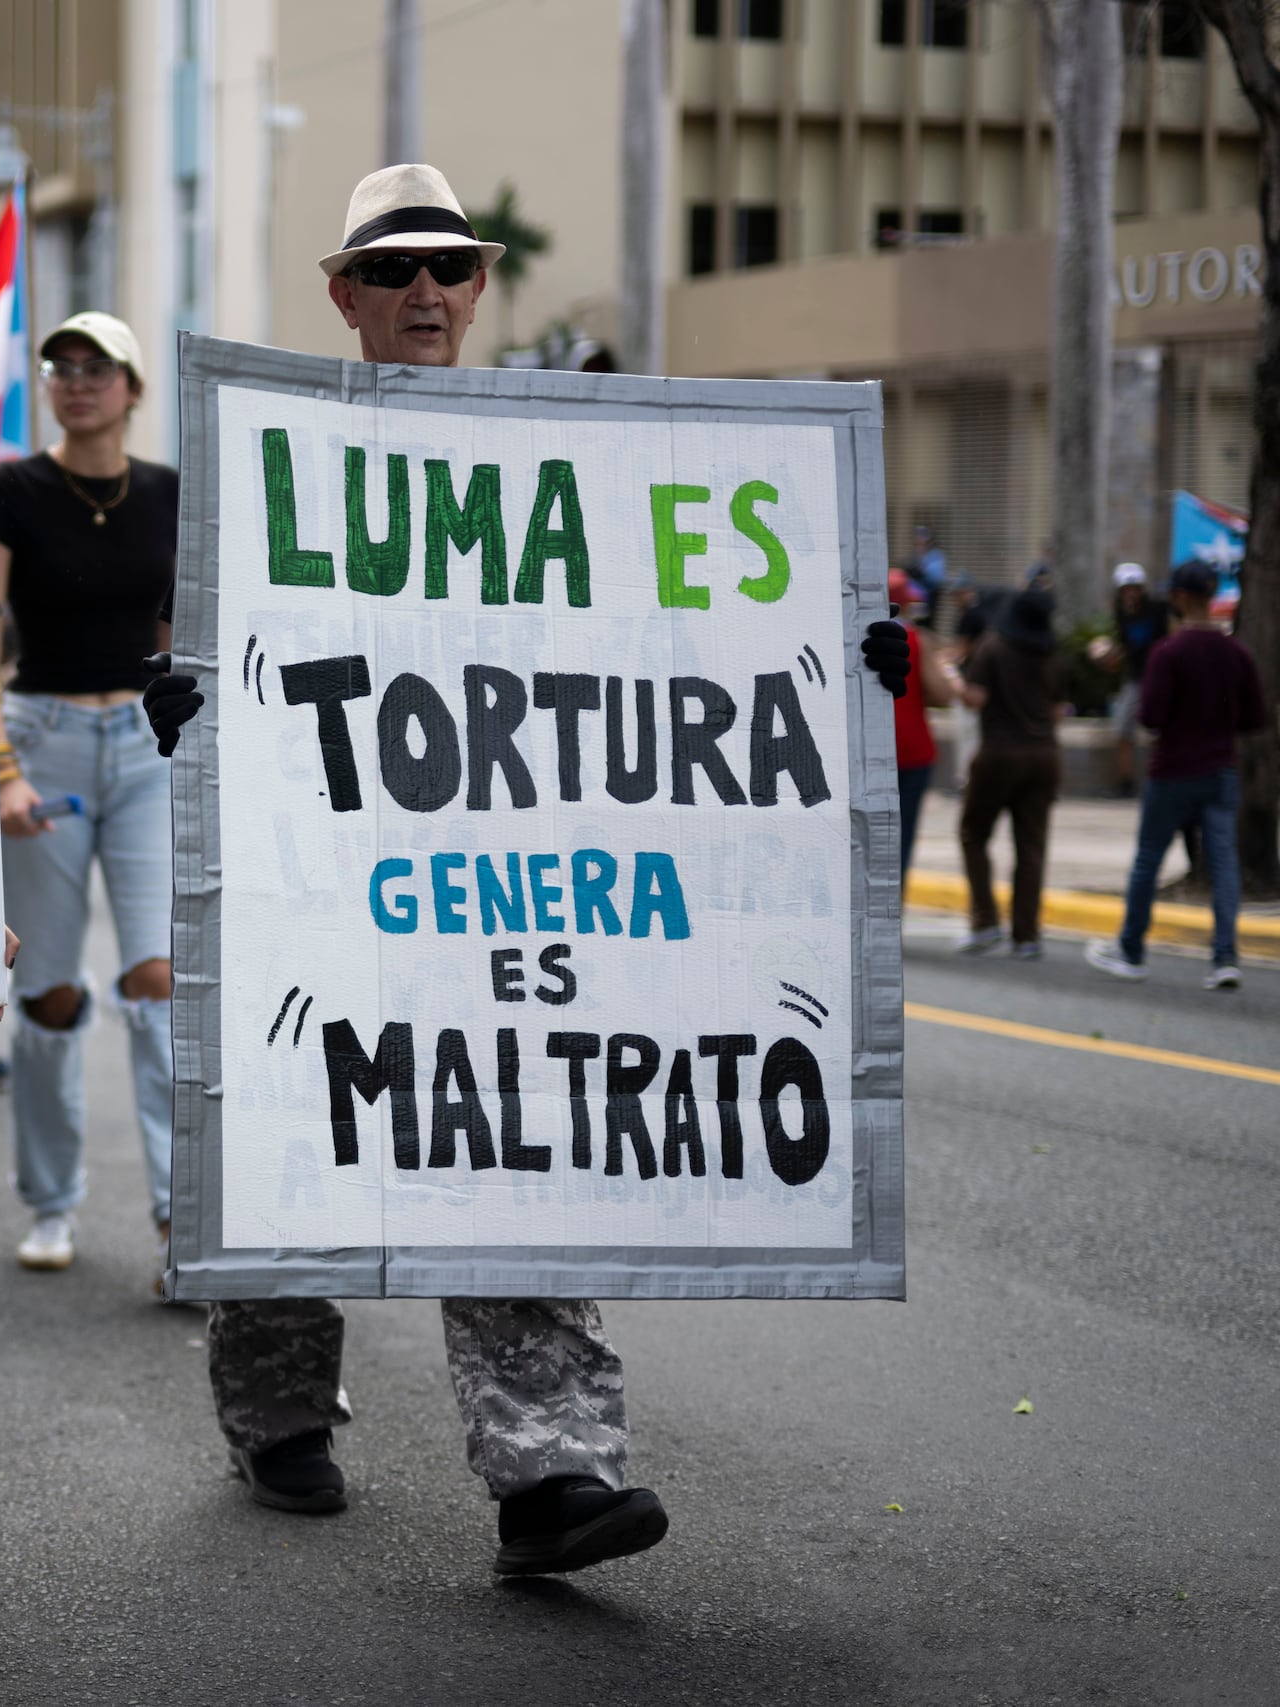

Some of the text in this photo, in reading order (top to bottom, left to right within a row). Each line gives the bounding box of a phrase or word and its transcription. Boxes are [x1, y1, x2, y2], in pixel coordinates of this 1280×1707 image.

[262, 428, 791, 611] LUMA ES
[368, 848, 691, 941] GENERA
[490, 943, 577, 1006] ES
